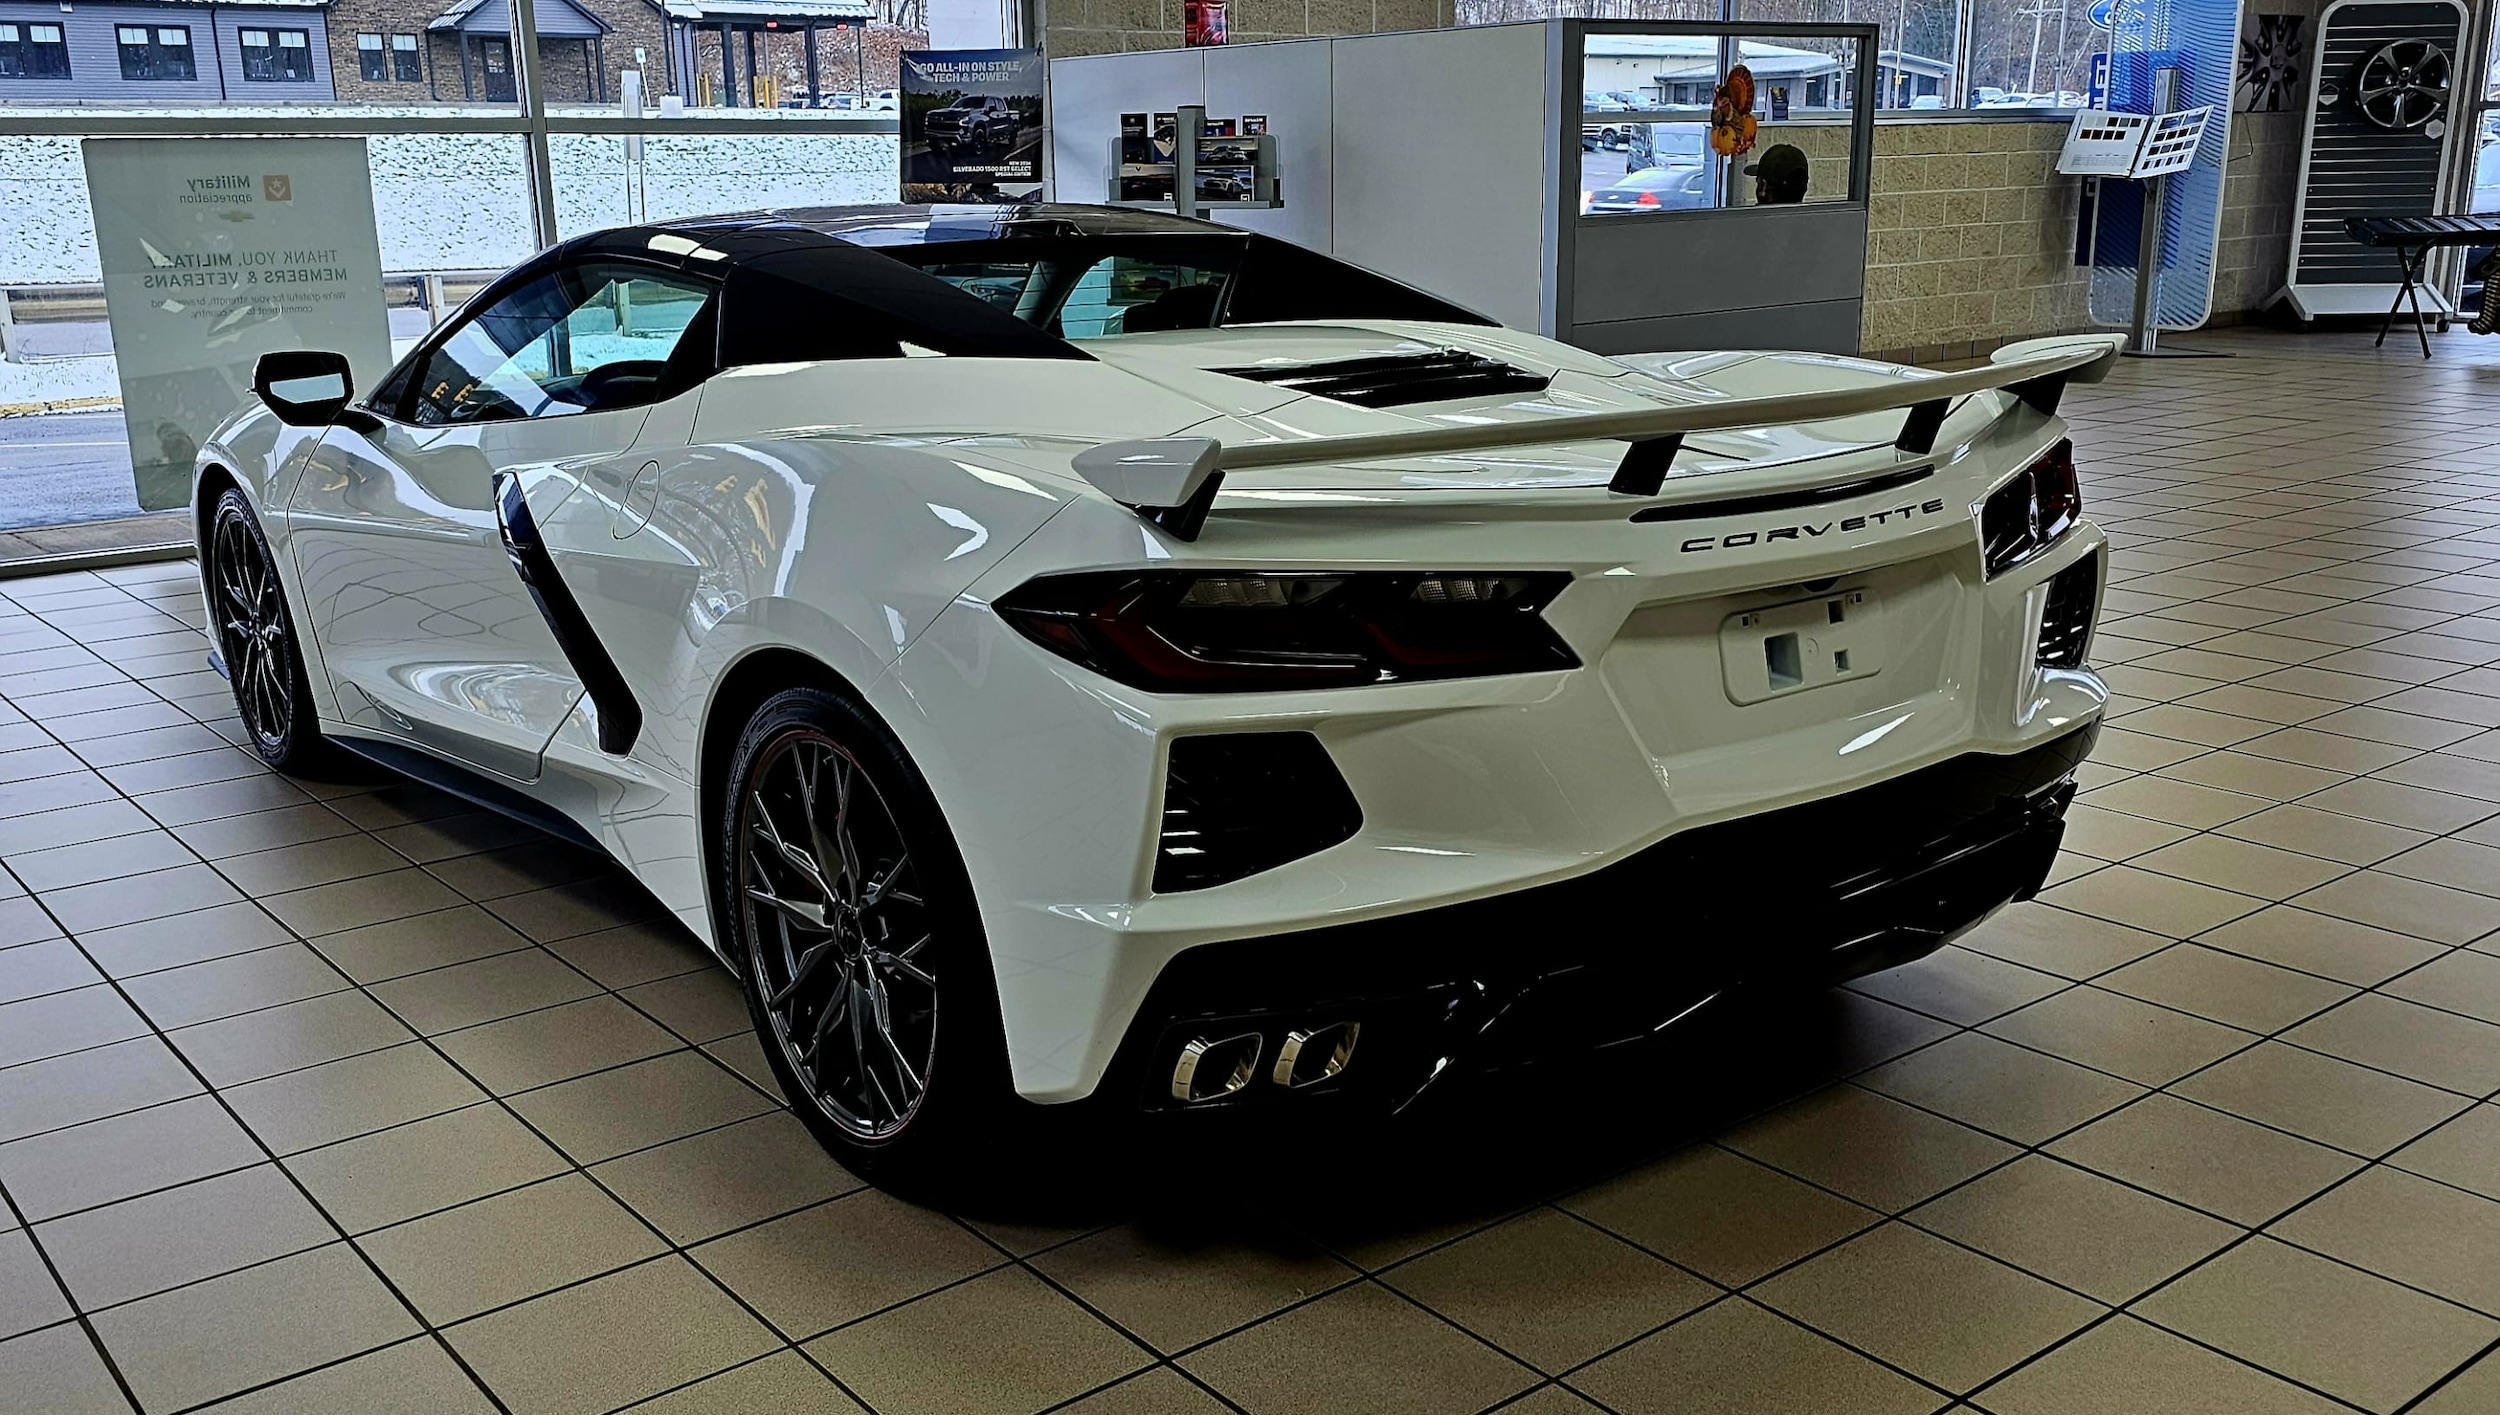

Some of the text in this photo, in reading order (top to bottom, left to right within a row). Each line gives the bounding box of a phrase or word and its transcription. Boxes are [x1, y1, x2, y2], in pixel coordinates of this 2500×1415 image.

[920, 60, 1023, 73] GO ALL-IN ON STYLE,
[932, 72, 1010, 83] TECH & POWER
[1680, 498, 1944, 553] CORVETTE
